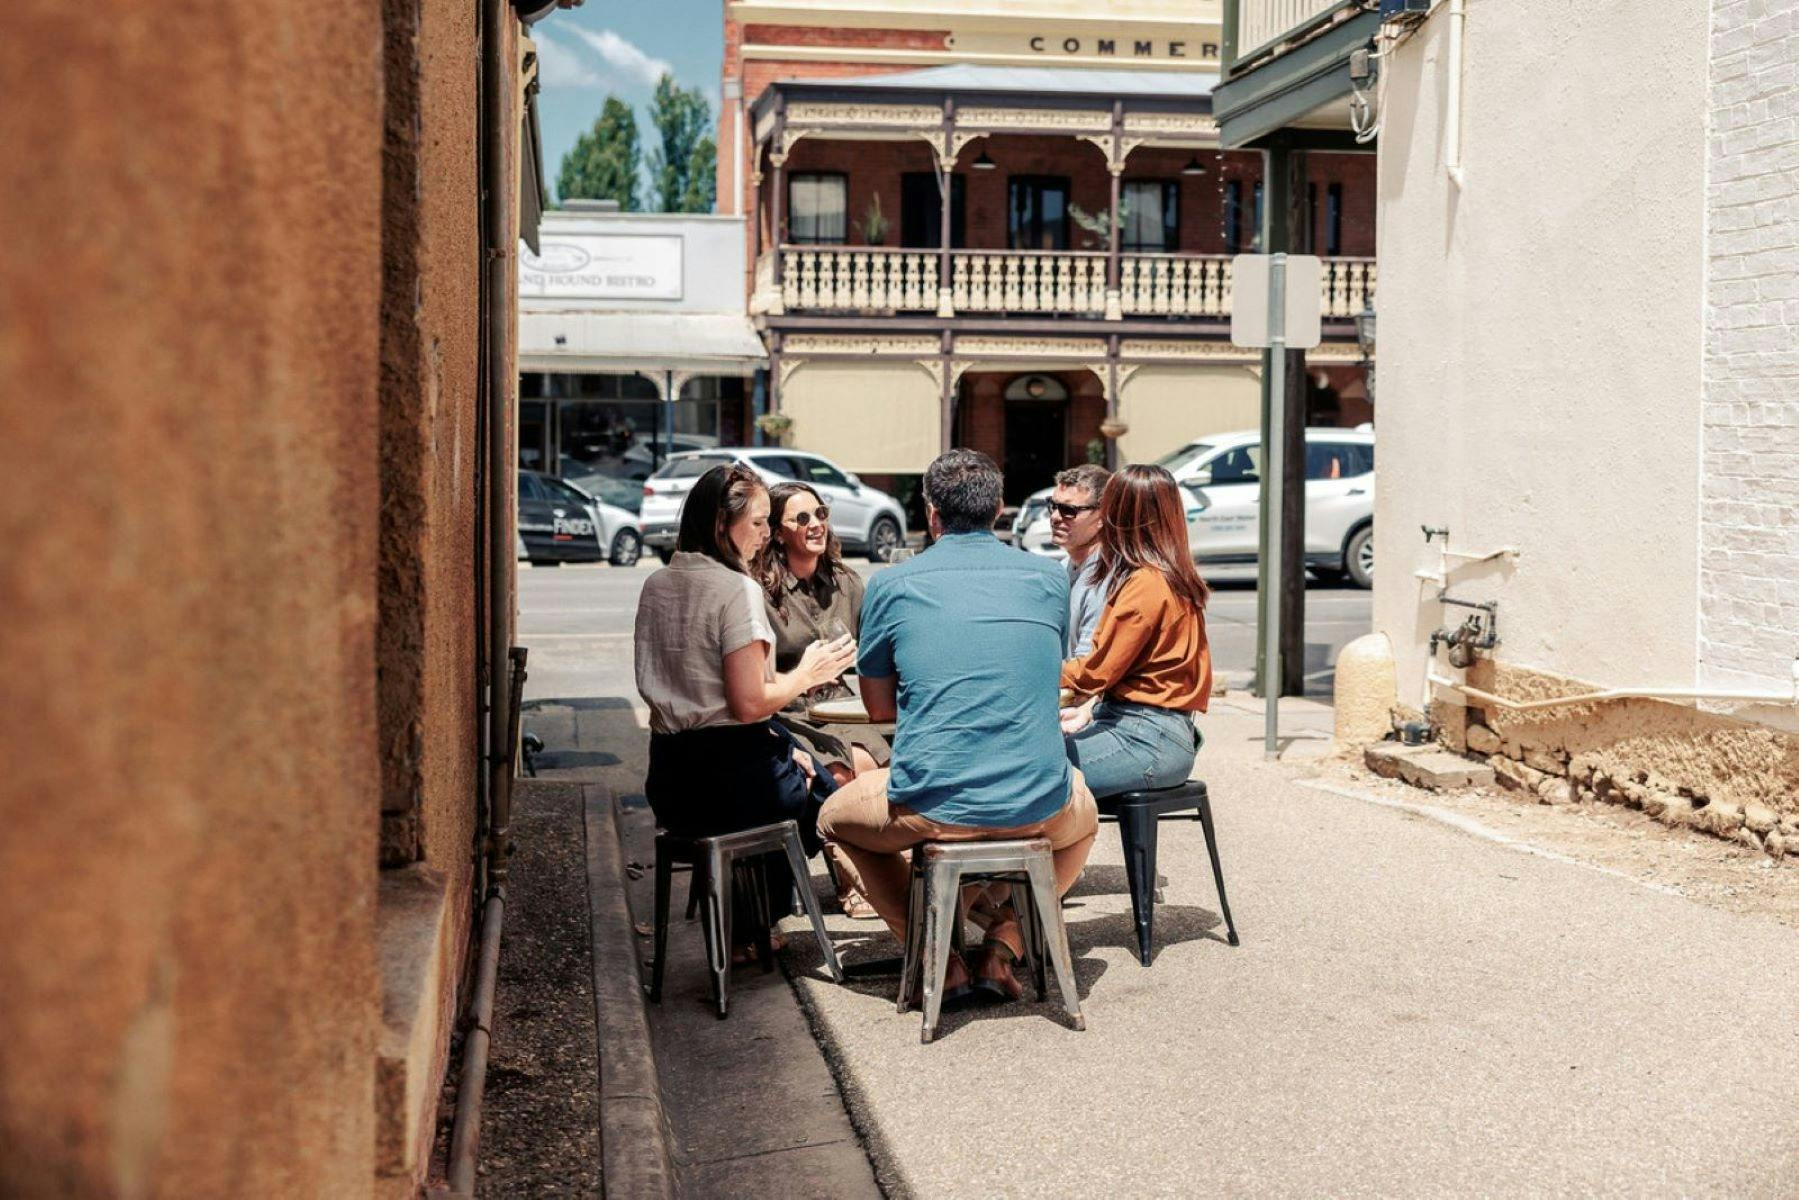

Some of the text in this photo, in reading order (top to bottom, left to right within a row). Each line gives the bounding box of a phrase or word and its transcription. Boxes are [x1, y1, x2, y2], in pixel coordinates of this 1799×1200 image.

[1030, 36, 1218, 57] COMMER
[519, 274, 656, 288] ND HOUND BISTRO
